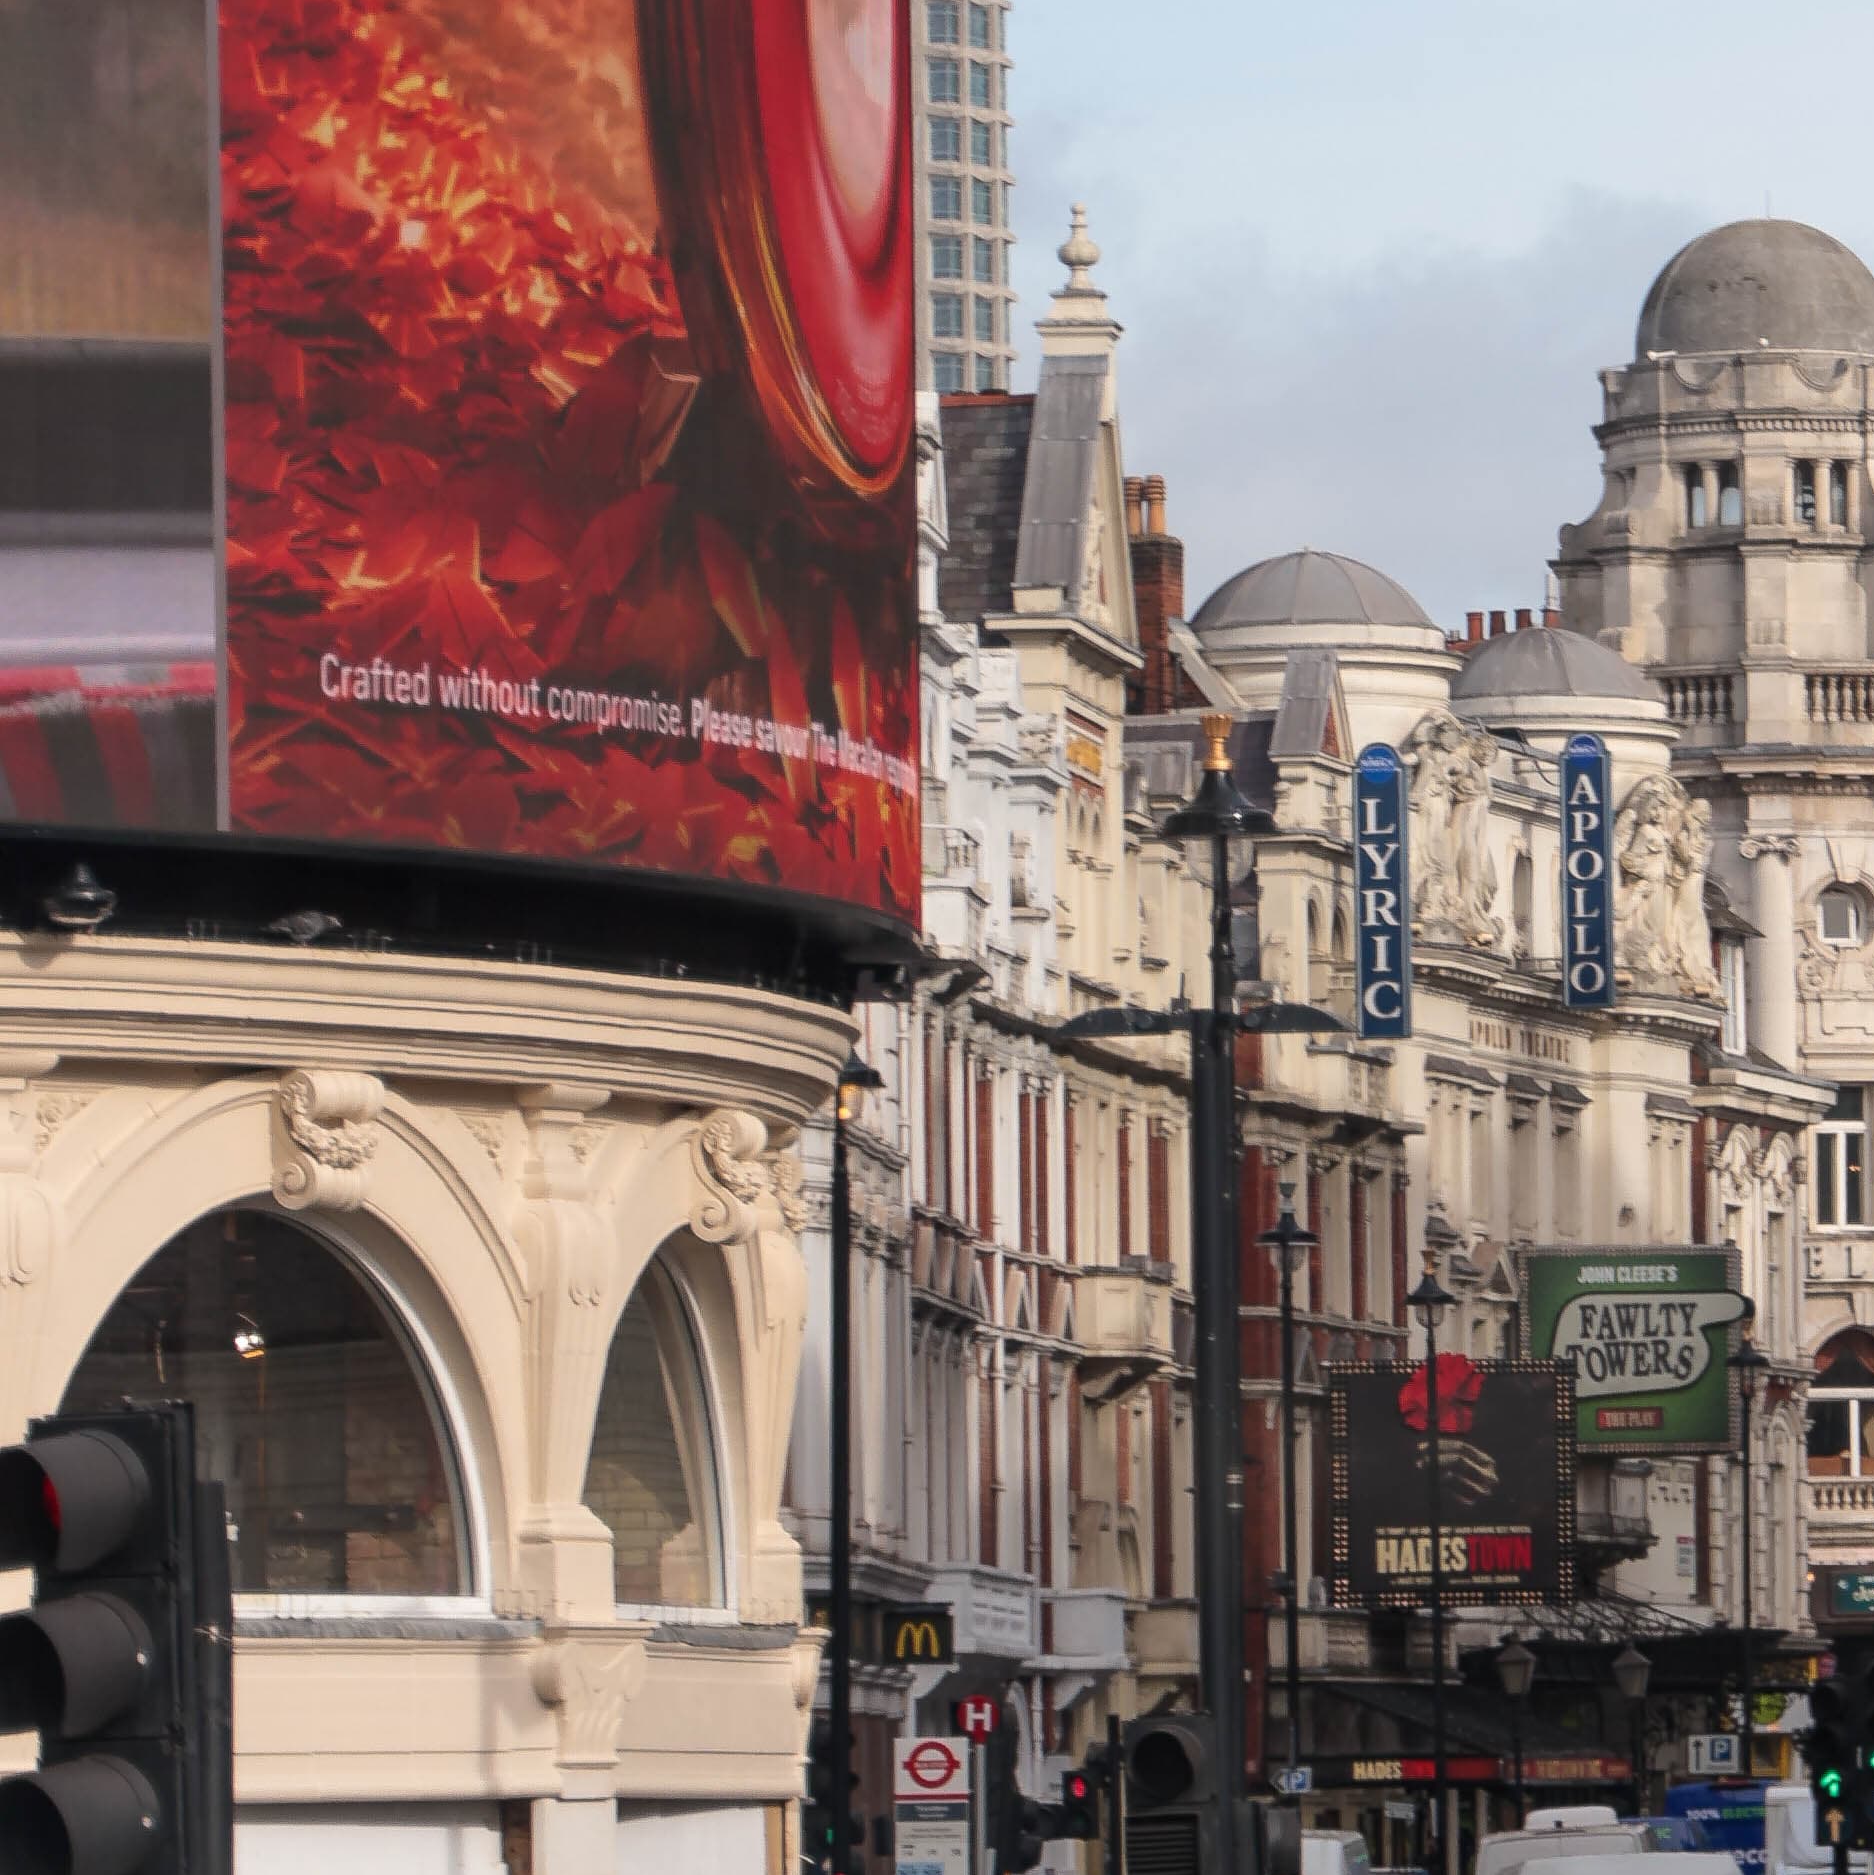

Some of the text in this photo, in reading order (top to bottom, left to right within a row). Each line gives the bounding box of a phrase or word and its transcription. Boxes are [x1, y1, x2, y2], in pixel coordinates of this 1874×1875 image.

[319, 652, 431, 707] Crafted
[438, 665, 542, 719] without
[547, 689, 686, 737] compromise.
[690, 696, 753, 749] Please
[1360, 797, 1401, 1019] LYRIC
[1567, 773, 1606, 994] APOLLO
[1579, 1302, 1698, 1340] FAWLTY
[1565, 1339, 1694, 1383] TOWERS
[1375, 1535, 1533, 1574] HADESTOWN
